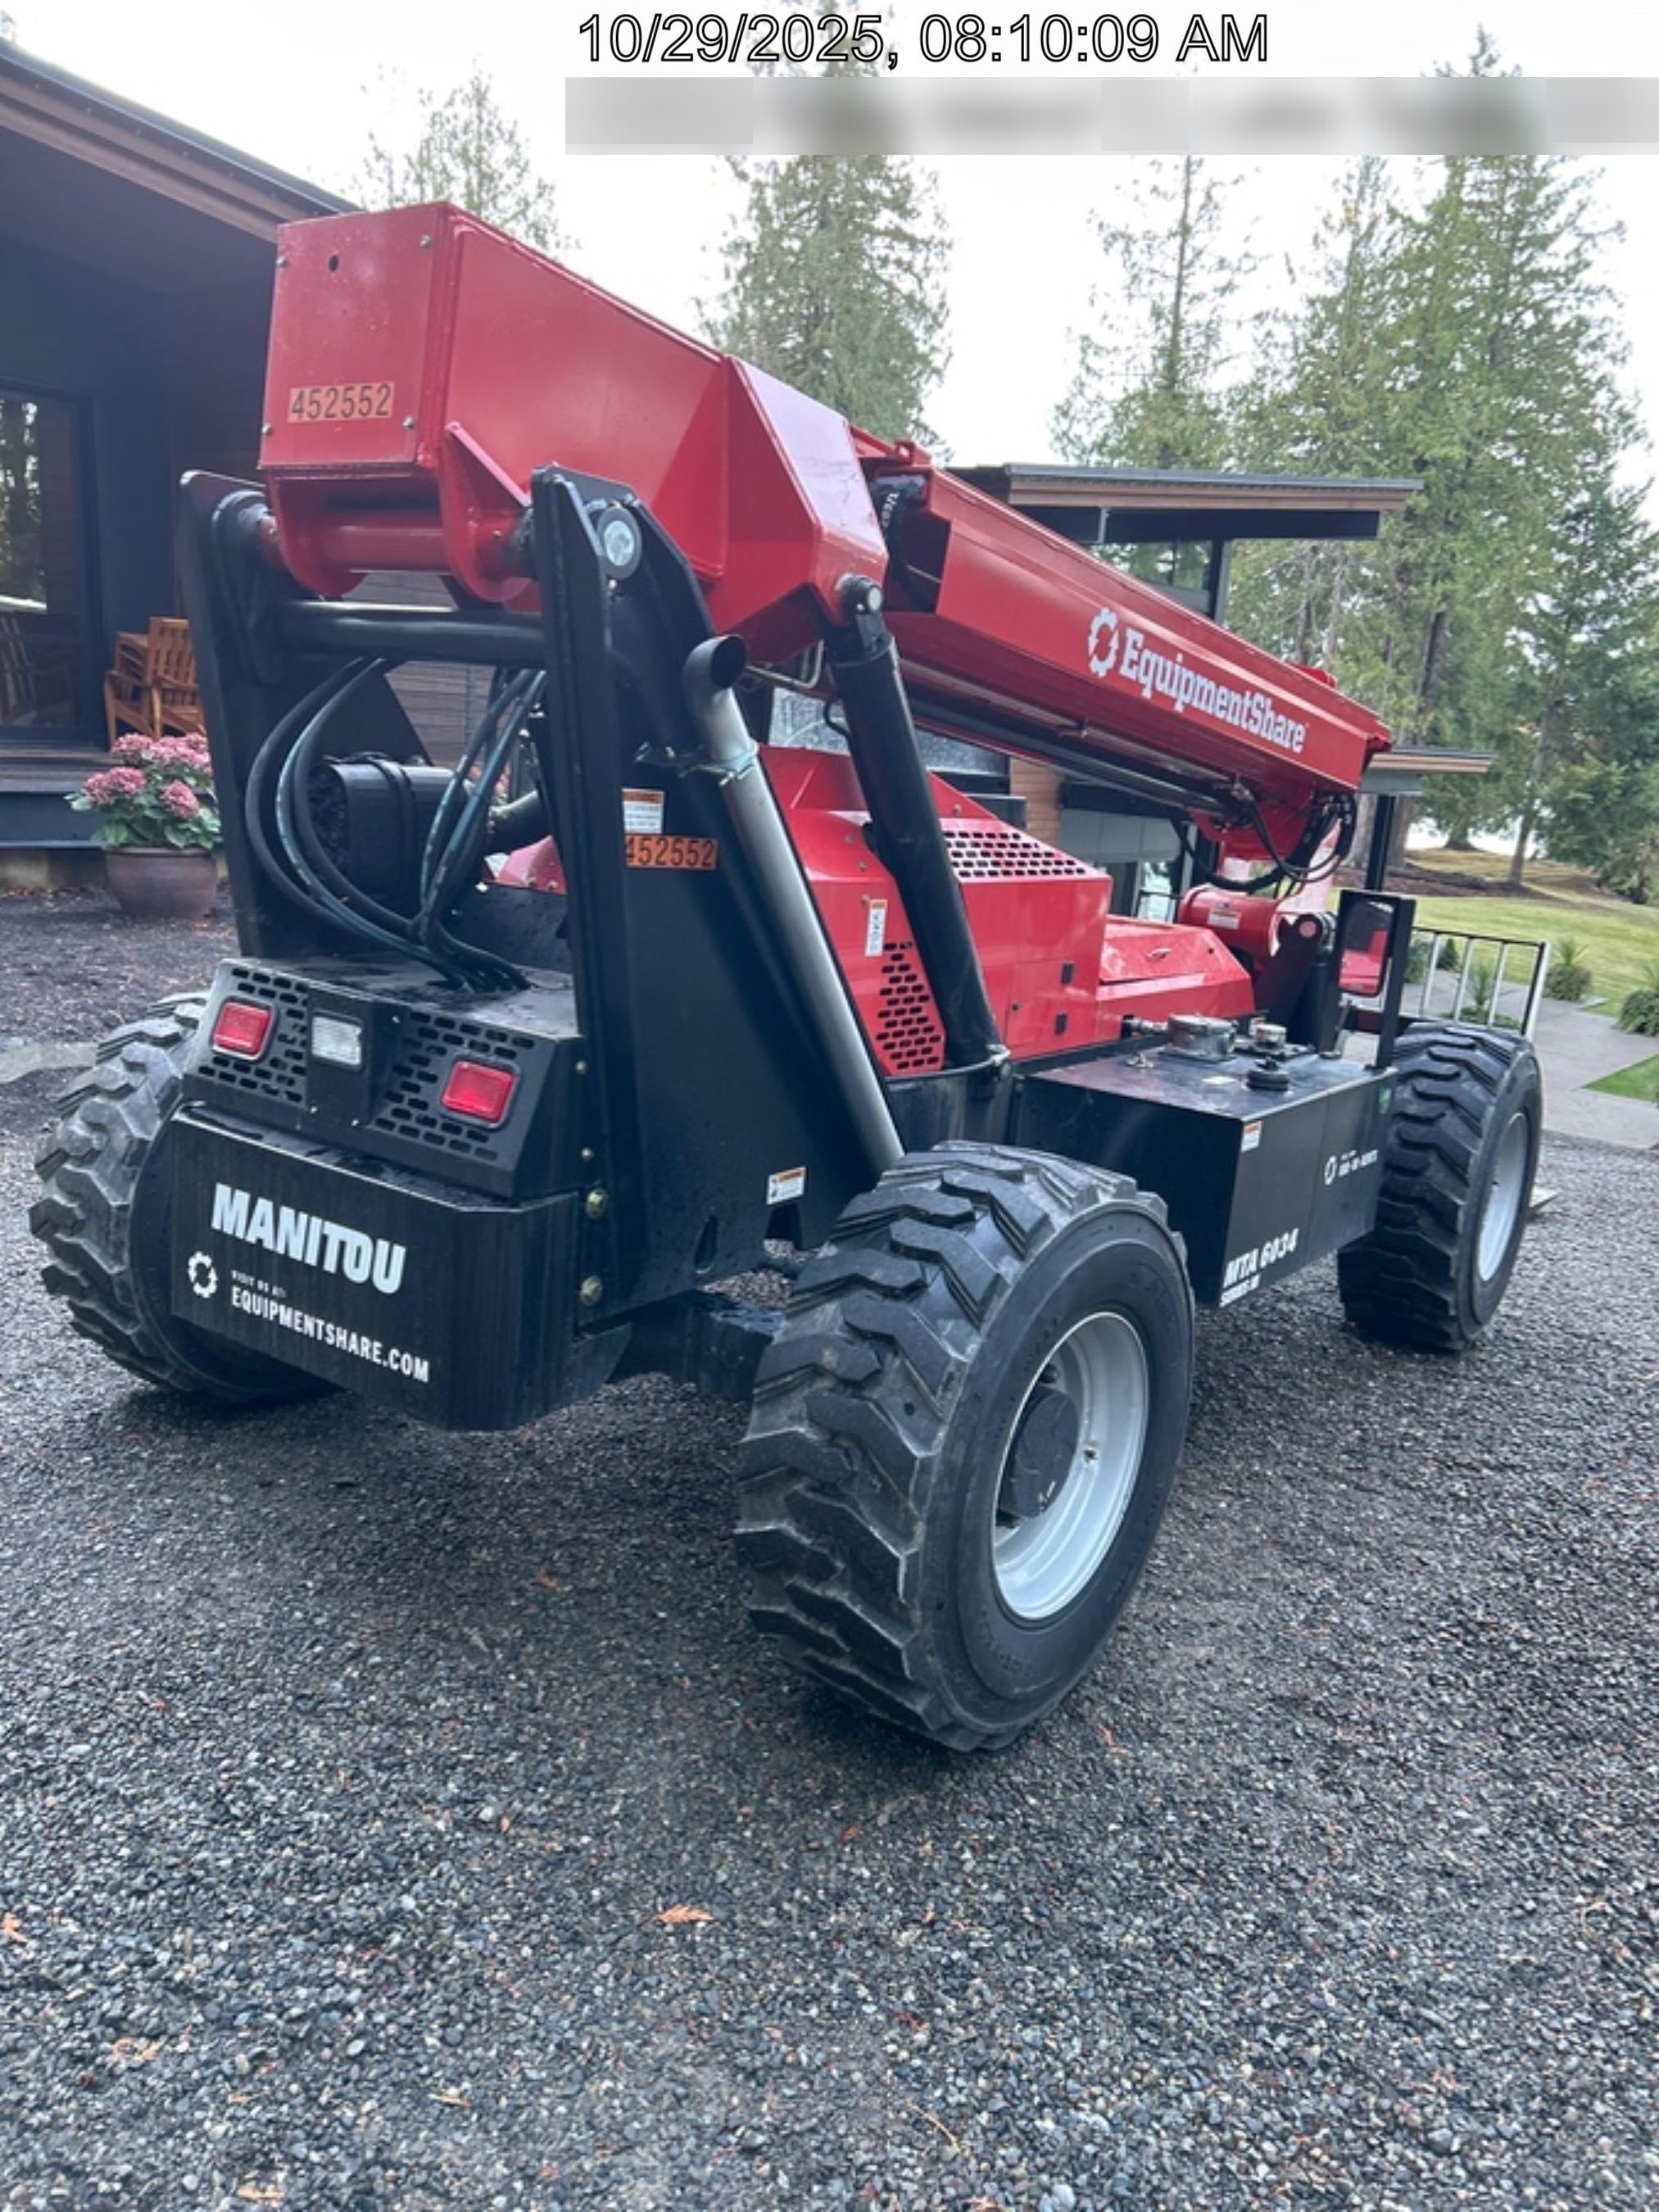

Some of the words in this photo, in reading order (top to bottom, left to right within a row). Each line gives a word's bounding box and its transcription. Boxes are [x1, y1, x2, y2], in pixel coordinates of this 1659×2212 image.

[292, 383, 392, 419] 452552
[1119, 628, 1306, 754] EquipmentShare
[626, 836, 714, 867] 452552
[211, 1182, 406, 1294] MANITOU
[1223, 1248, 1259, 1288] MTA
[1260, 1227, 1299, 1268] 6034
[230, 1285, 430, 1383] EQUIPMENTSHARE.COM
